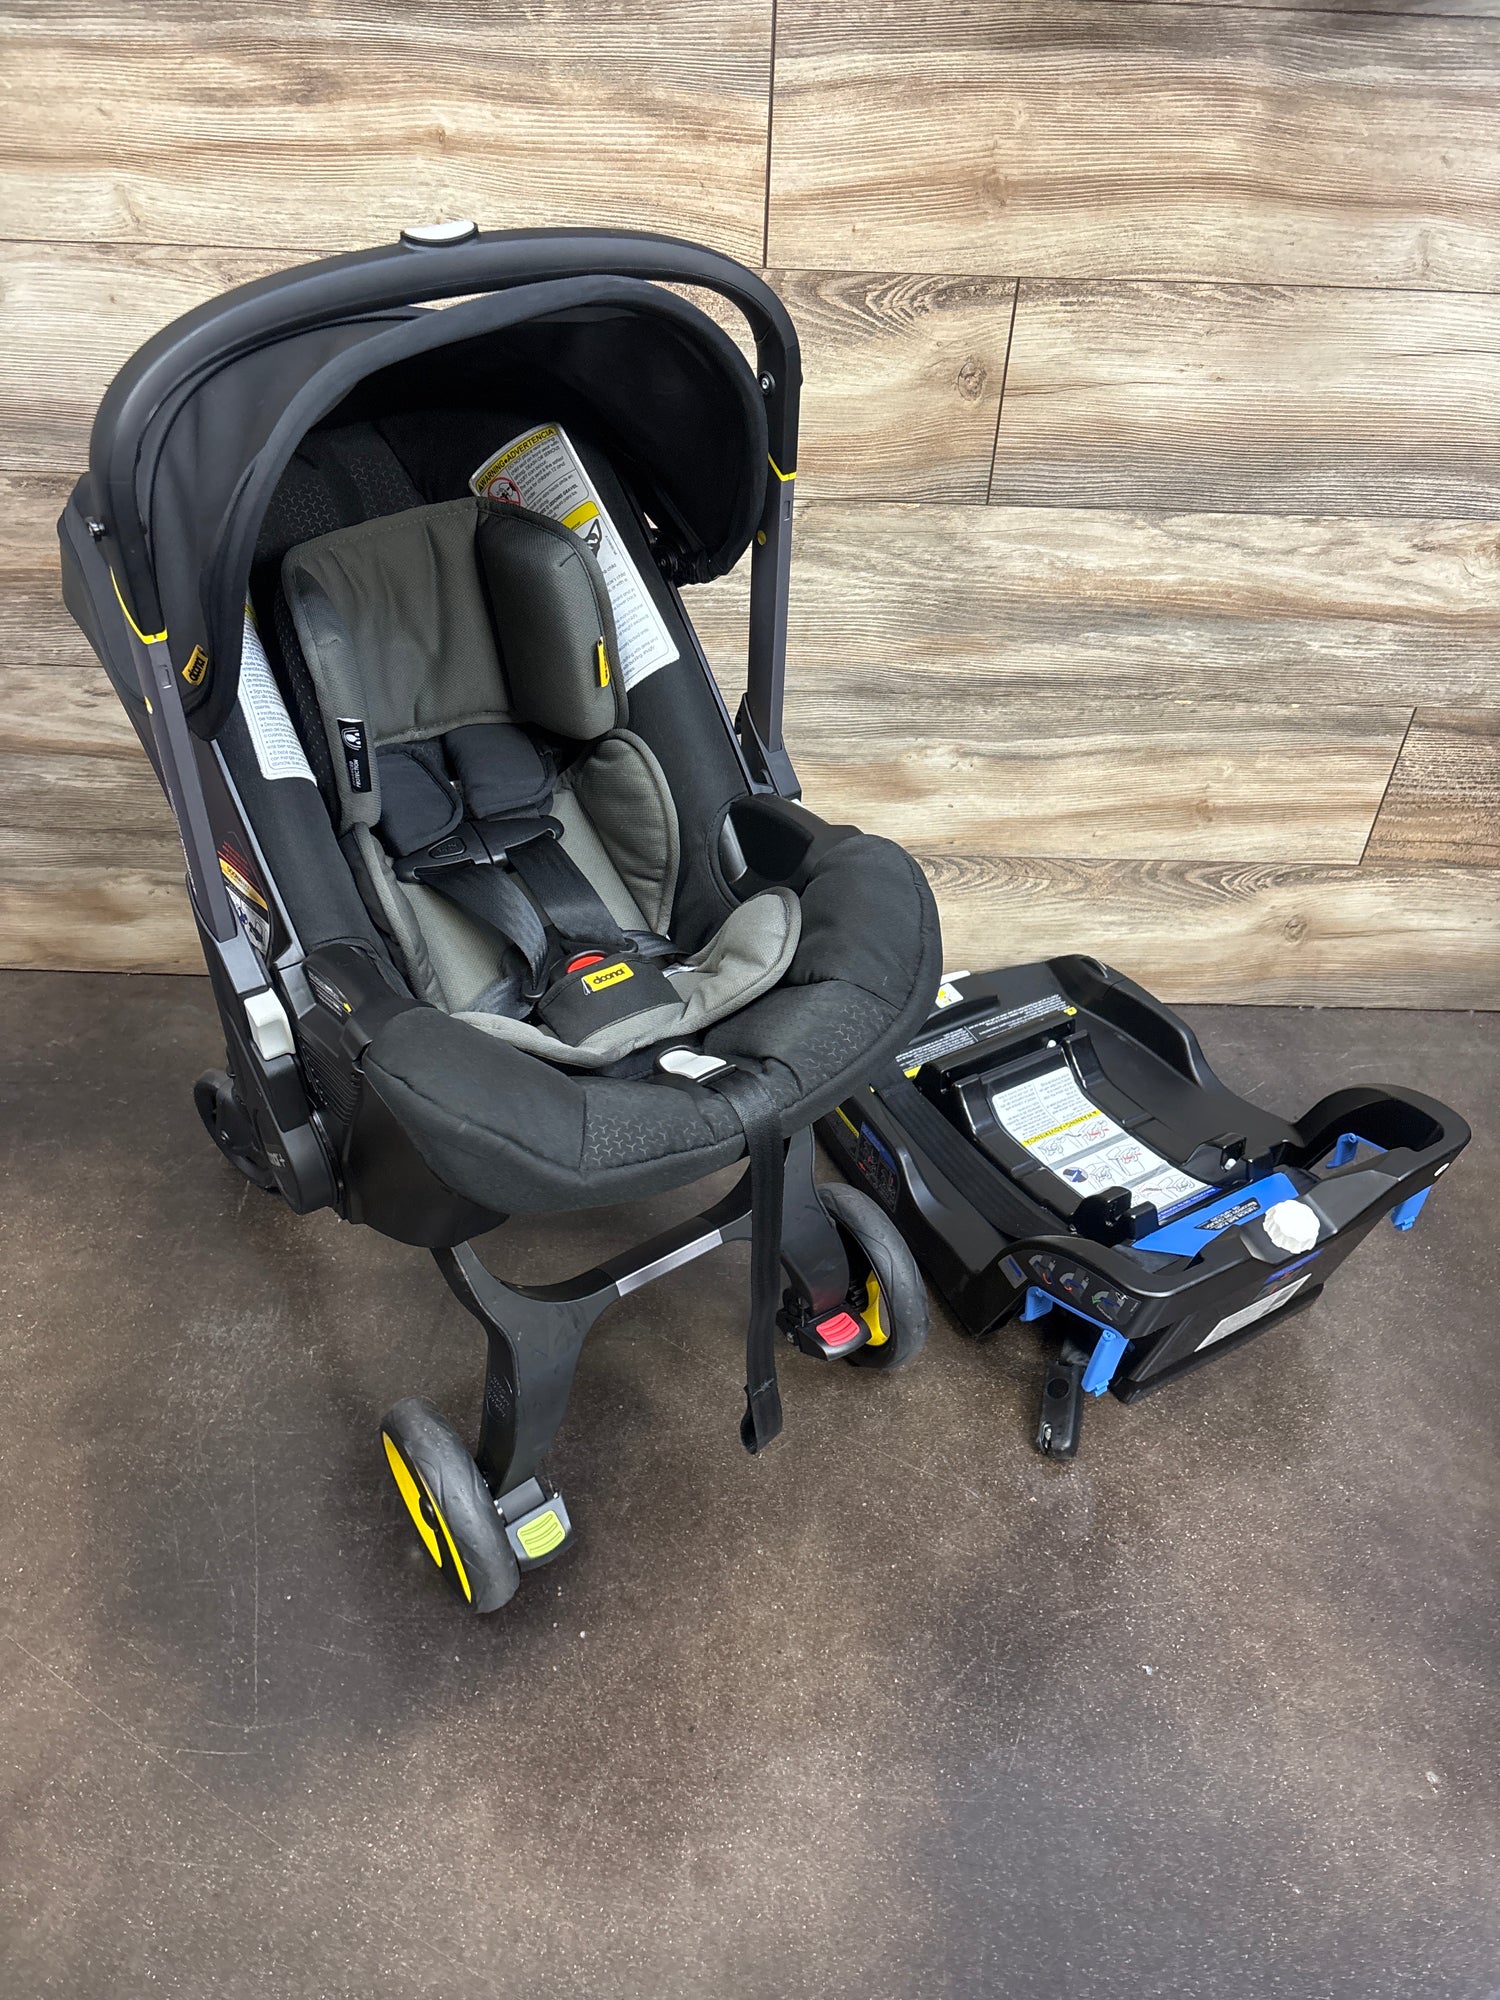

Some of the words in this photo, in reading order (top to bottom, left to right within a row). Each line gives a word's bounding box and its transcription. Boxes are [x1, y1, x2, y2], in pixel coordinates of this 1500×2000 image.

[481, 460, 508, 487] WARNING
[506, 428, 555, 461] ADVERTENCIA
[353, 758, 362, 788] PROTECTION
[593, 968, 626, 985] doona
